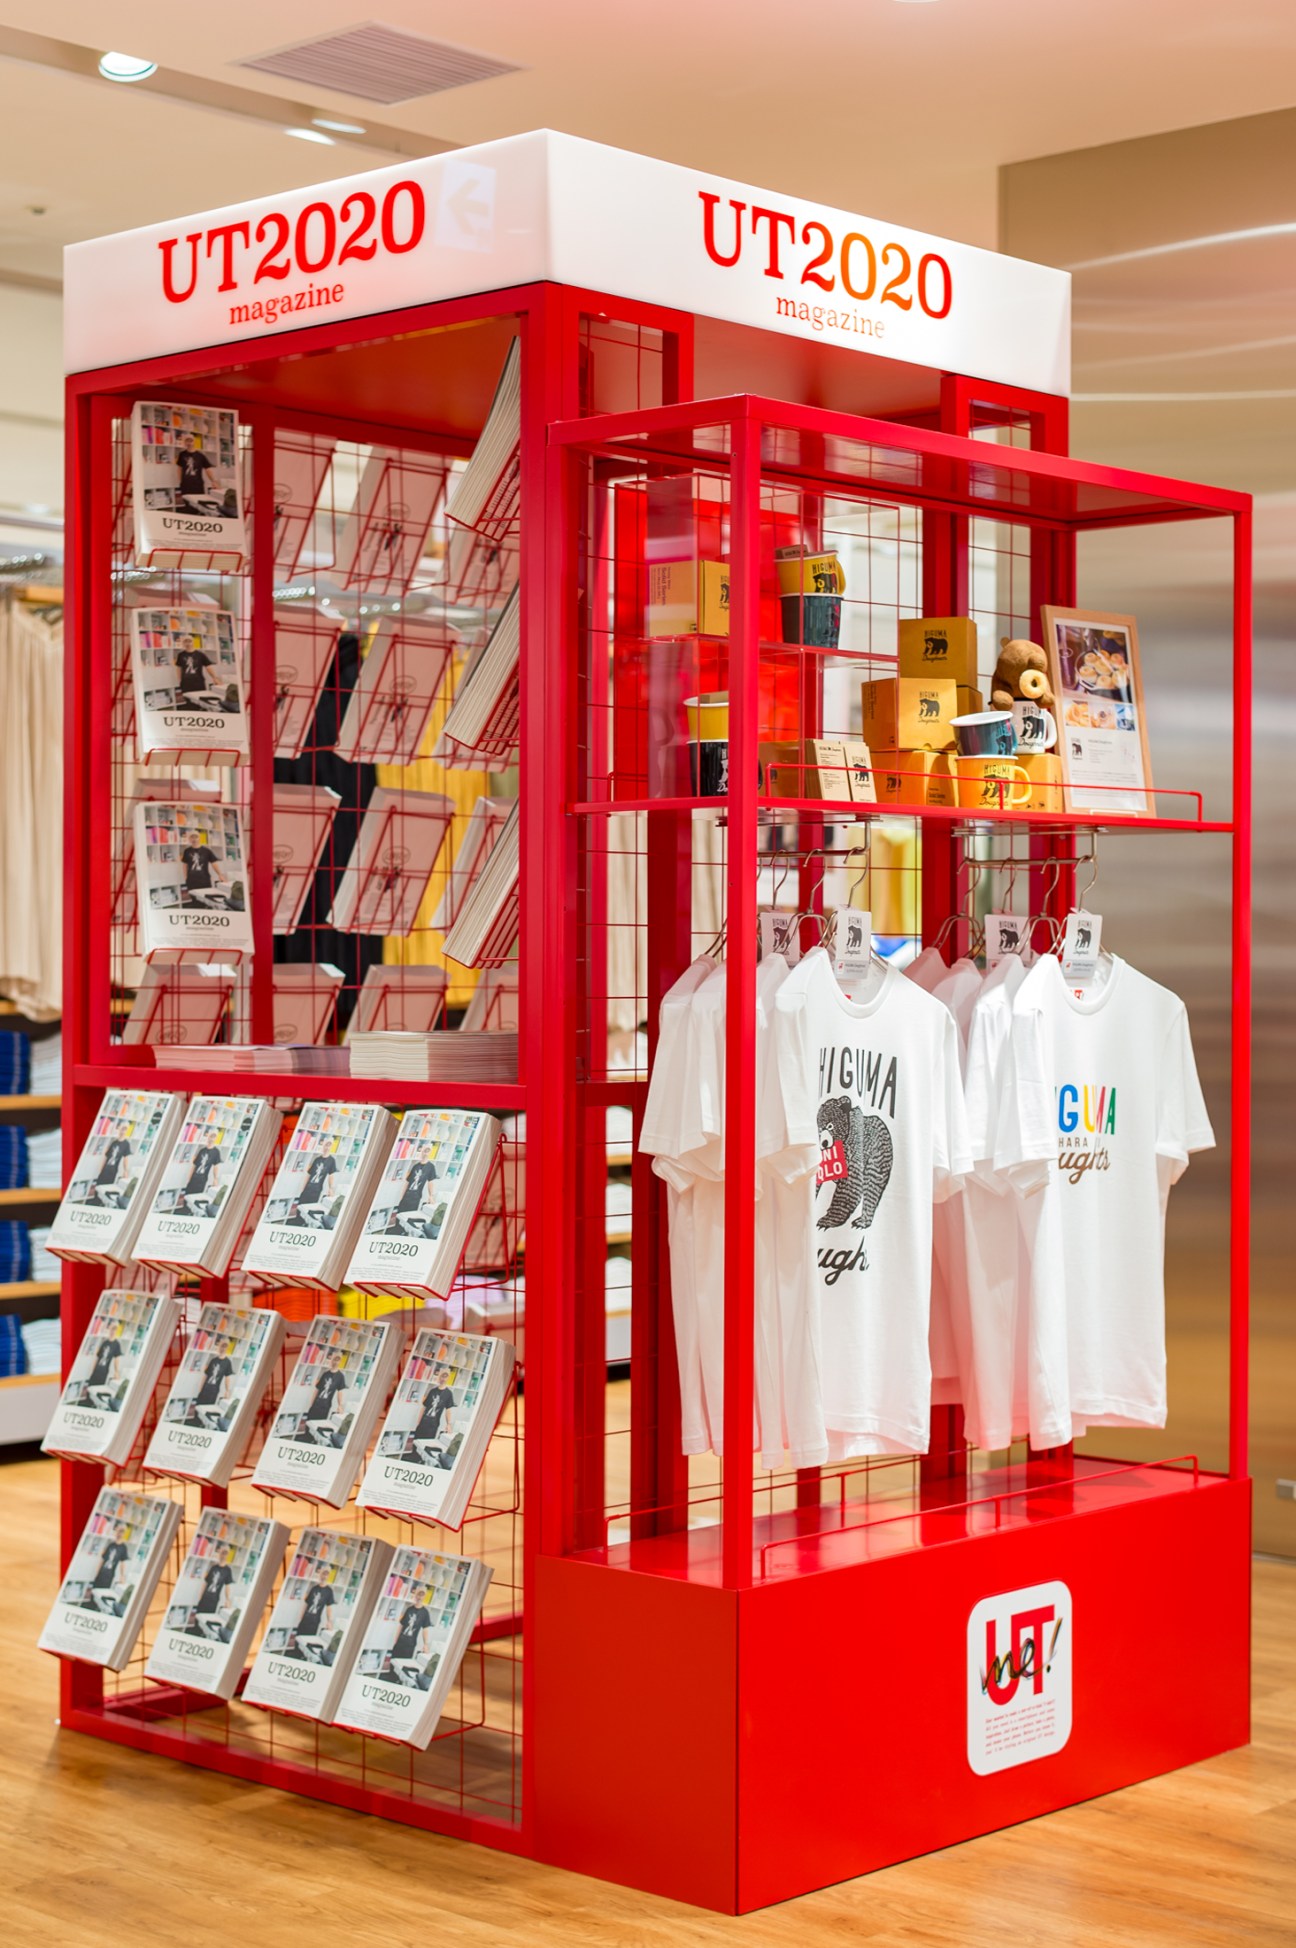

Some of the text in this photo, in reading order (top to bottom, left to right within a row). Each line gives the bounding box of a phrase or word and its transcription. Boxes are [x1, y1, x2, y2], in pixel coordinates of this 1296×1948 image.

[158, 180, 425, 303] UT2020
[698, 190, 953, 320] UT2020
[229, 282, 345, 325] magazine
[776, 296, 885, 339] magazine
[162, 517, 223, 534] UT2020
[163, 716, 225, 729] UT2020
[169, 914, 231, 928] UT2020
[70, 1210, 112, 1226] UT2020
[157, 1219, 200, 1235] UT2020
[269, 1230, 317, 1248] UT2020
[369, 1240, 419, 1258] UT2020
[63, 1411, 105, 1429] UT2020
[168, 1430, 213, 1449] UT2020
[277, 1446, 326, 1466] UT2020
[384, 1465, 434, 1488] UT2020
[64, 1611, 108, 1633] UT2020
[168, 1638, 215, 1660] UT2020
[986, 1604, 1055, 1706] UT
[267, 1661, 316, 1684] UT2020
[362, 1684, 411, 1708] UT2020
